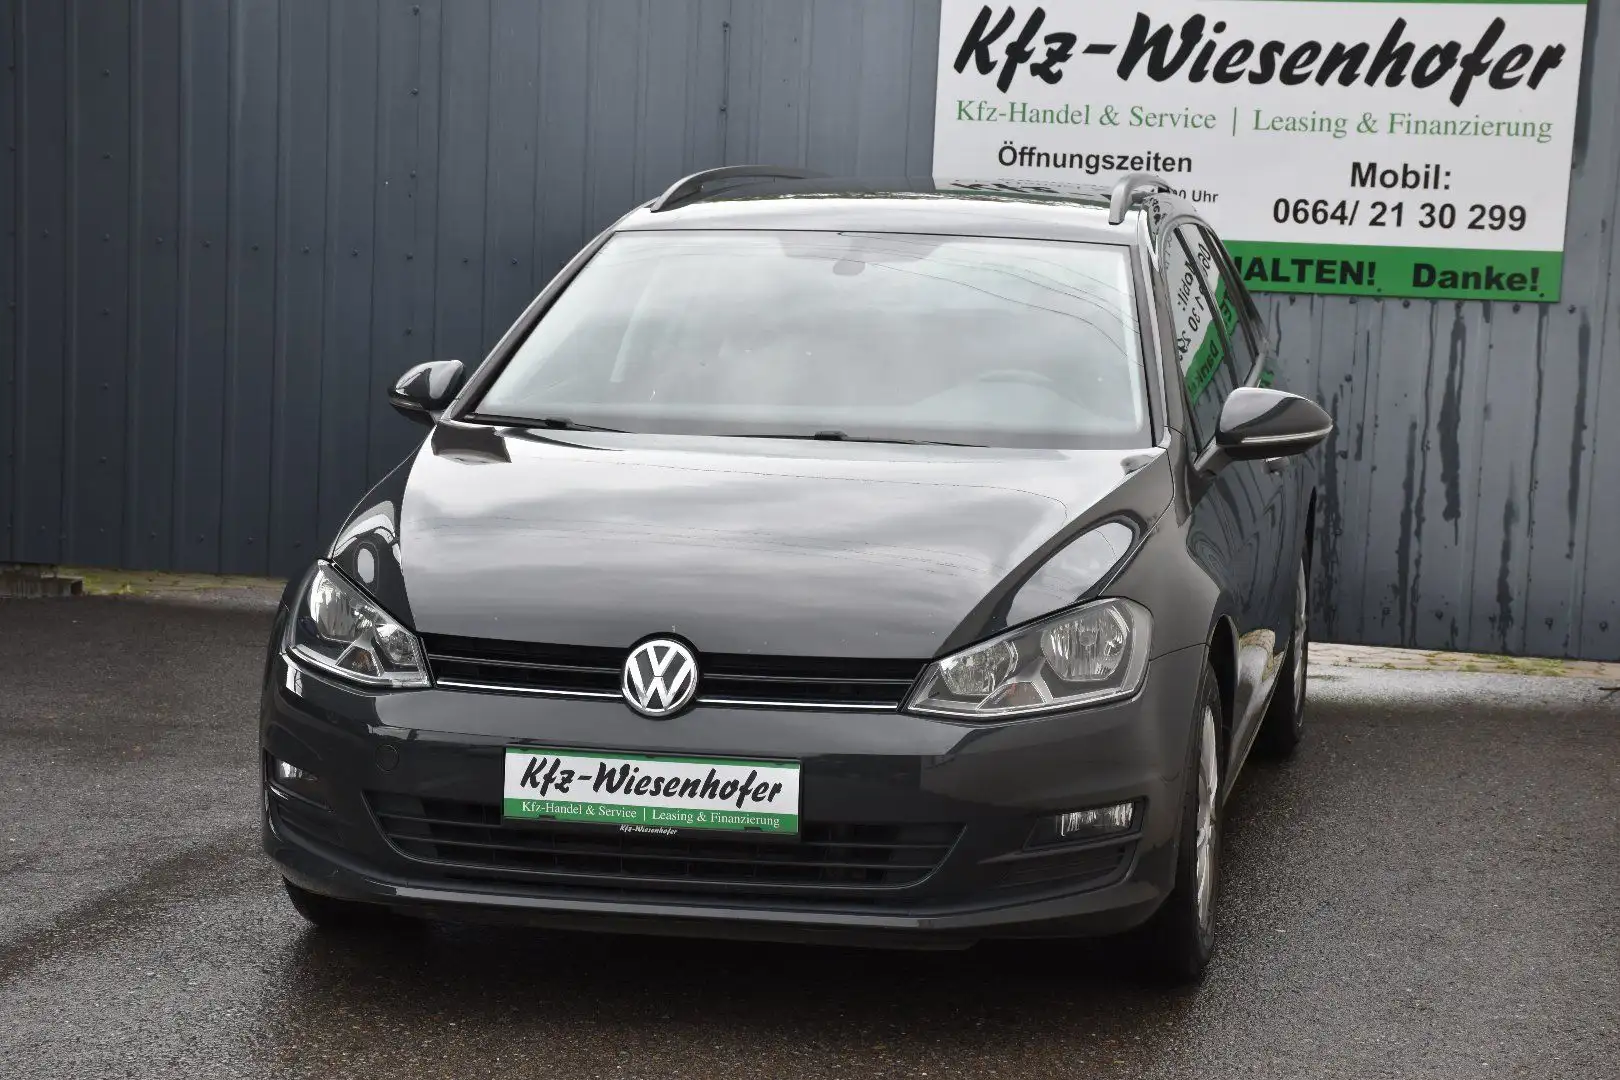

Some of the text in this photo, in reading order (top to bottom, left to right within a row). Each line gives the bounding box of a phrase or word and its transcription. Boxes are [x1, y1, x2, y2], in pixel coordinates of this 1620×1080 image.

[953, 5, 1566, 107] Kfz-Wiesenhofer
[956, 100, 1554, 143] Kfz-Handel & Service Leasing & Finanzierung
[998, 141, 1193, 174] Öffnungszeiten
[1350, 162, 1452, 190] Mobil:
[1191, 189, 1219, 203] Uhr
[1273, 197, 1528, 232] 0664/ 21 30 299
[1412, 262, 1540, 292] Danke!
[520, 756, 783, 809] Kfz-Wiesenhofer
[522, 801, 781, 828] Kfz-Handel & Service Leasing & Finanzierung
[619, 824, 678, 836] Kfz-Wiesenhofer
